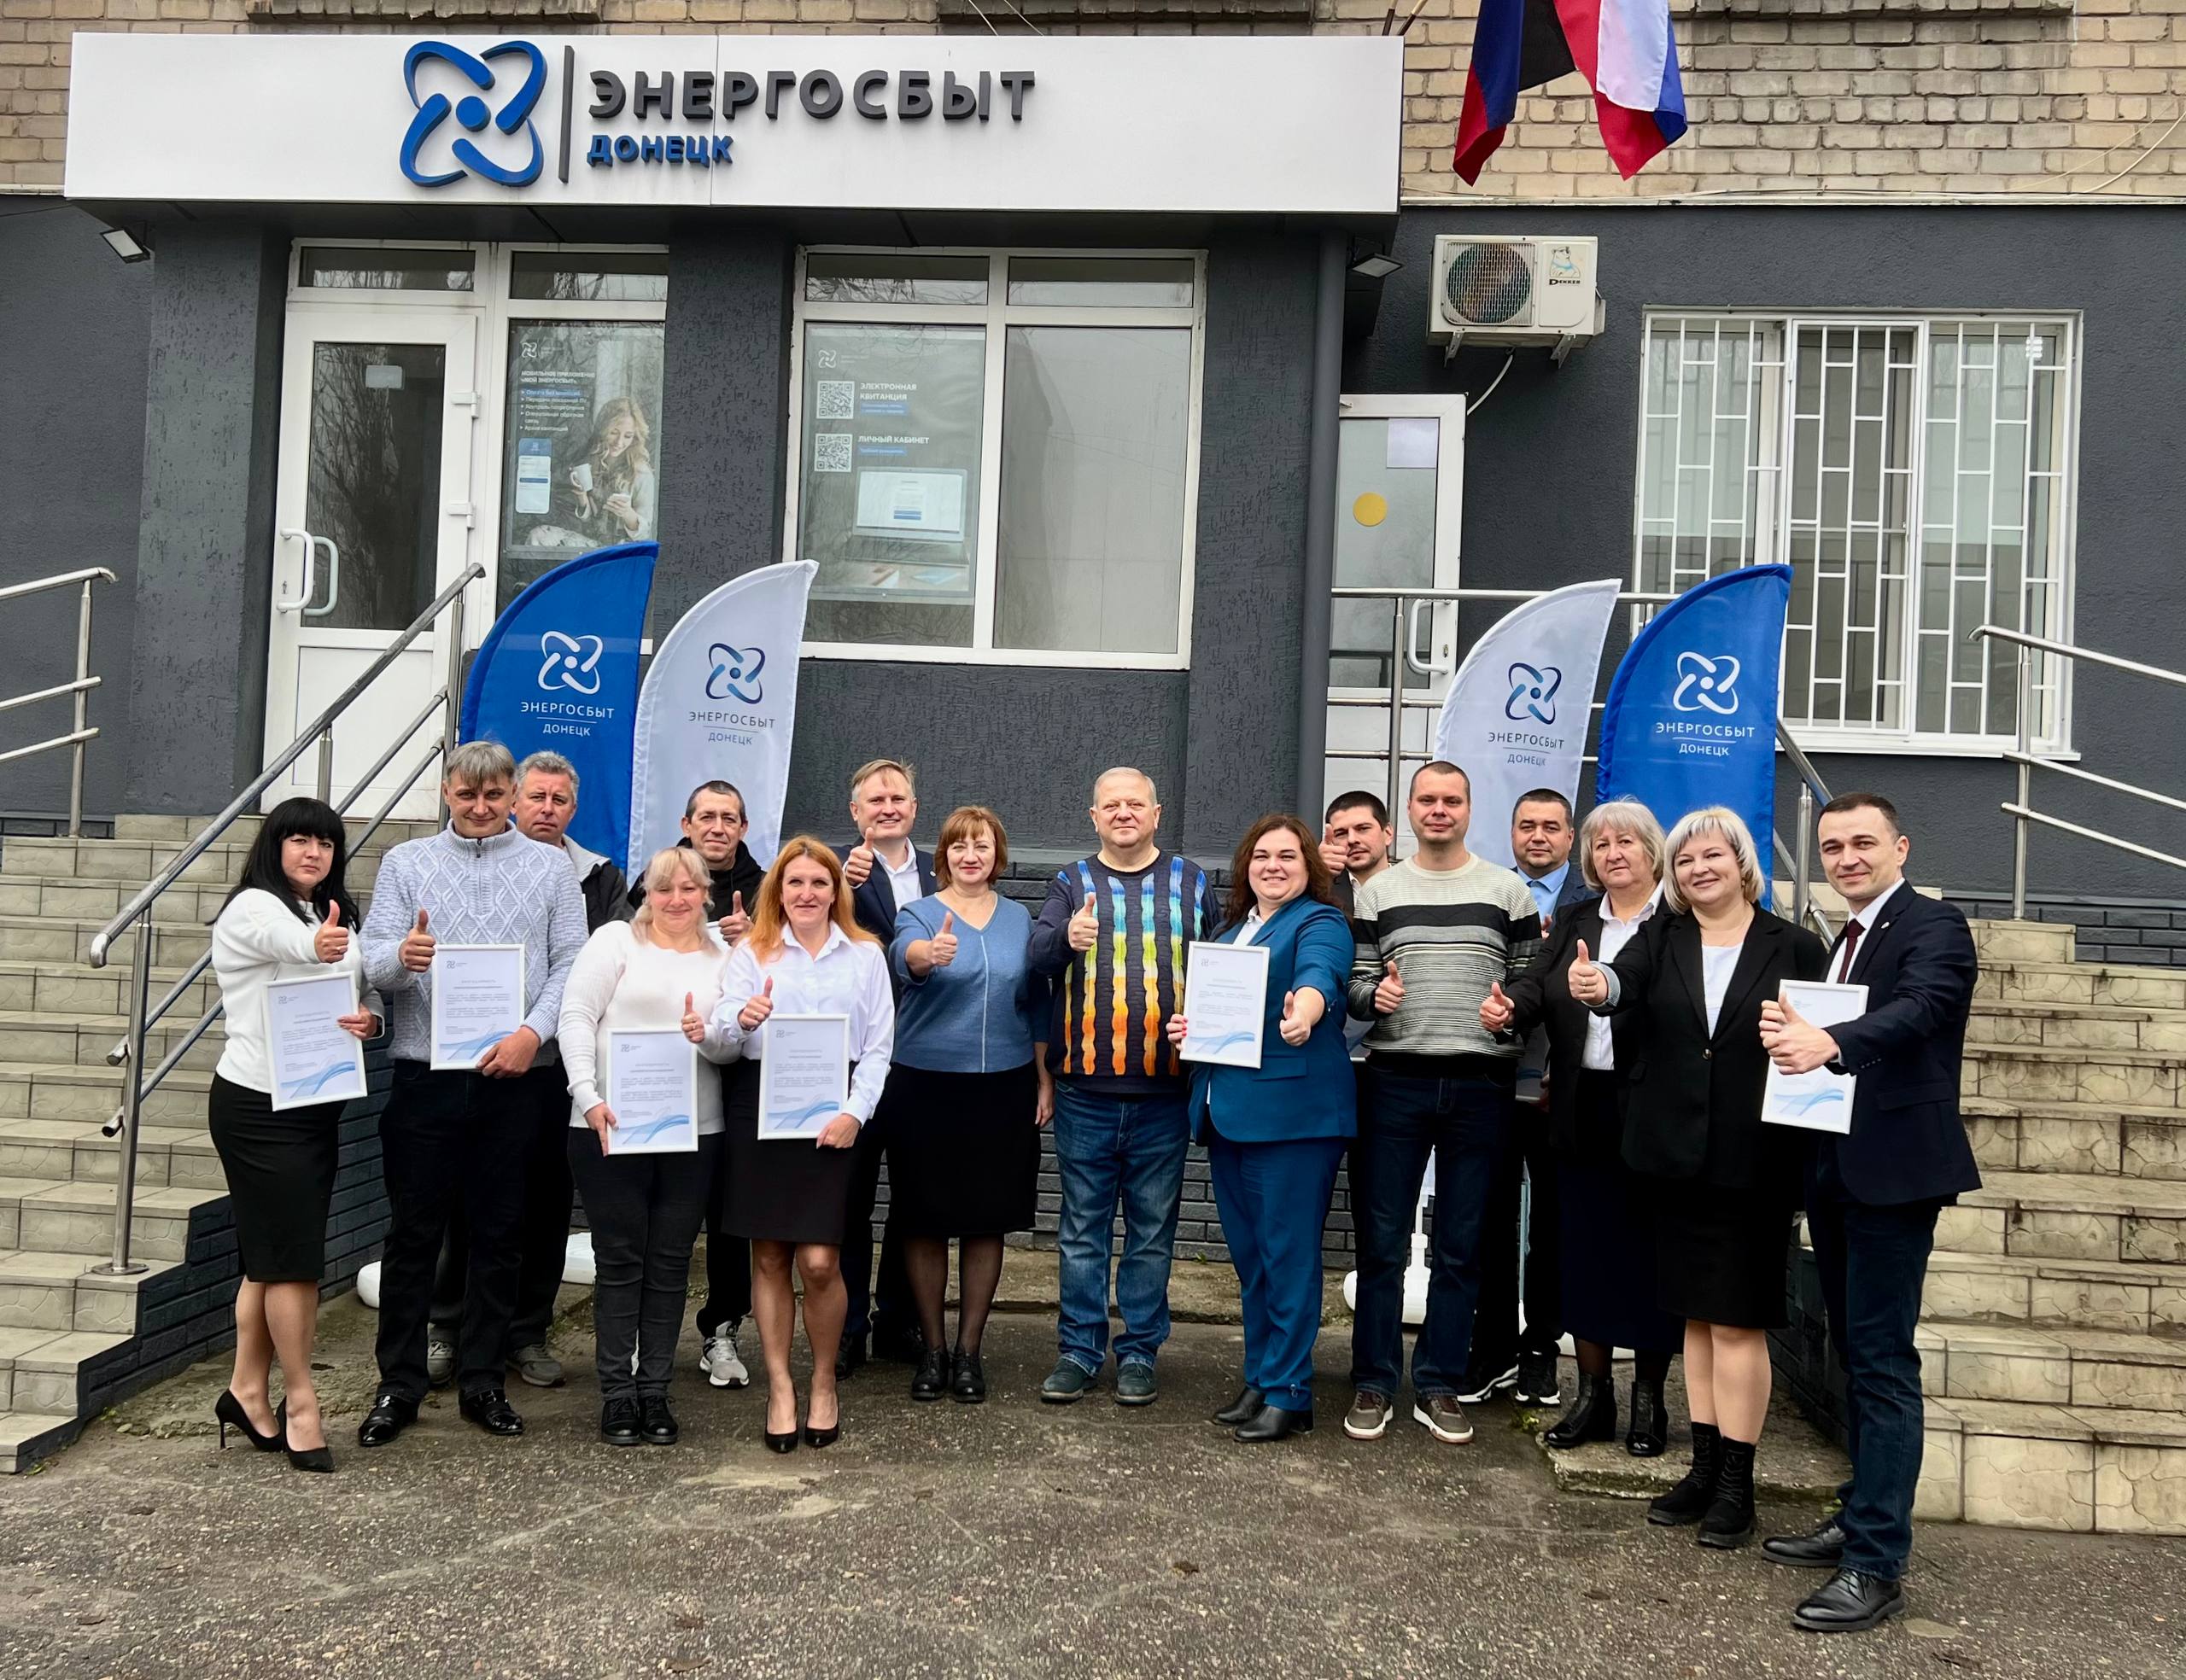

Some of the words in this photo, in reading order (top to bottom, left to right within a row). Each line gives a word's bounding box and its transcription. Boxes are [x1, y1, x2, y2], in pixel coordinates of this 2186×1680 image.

[588, 69, 1036, 120] ЭНЕРГОСБЫТ
[587, 135, 734, 168] ДОНЕЦК
[860, 382, 917, 391] ЭЛЕКТРОННАЯ
[859, 393, 908, 401] КВИТАНЦИЯ
[894, 436, 930, 445] КАБИНЕТ
[521, 702, 615, 719] ЭНЕРГОСБЫТ
[688, 711, 776, 729] ЭНЕРГОСБЫТ
[542, 723, 591, 737] ДОНЕЦК
[1655, 722, 1756, 738] ЭНЕРГОСБЫТ
[708, 732, 753, 746] ДОНЕЦК
[1488, 732, 1565, 750] ЭНЕРГОСБЫТ
[1678, 743, 1730, 756] ДОНЕЦК
[1507, 754, 1546, 767] ДОНЕЦК
